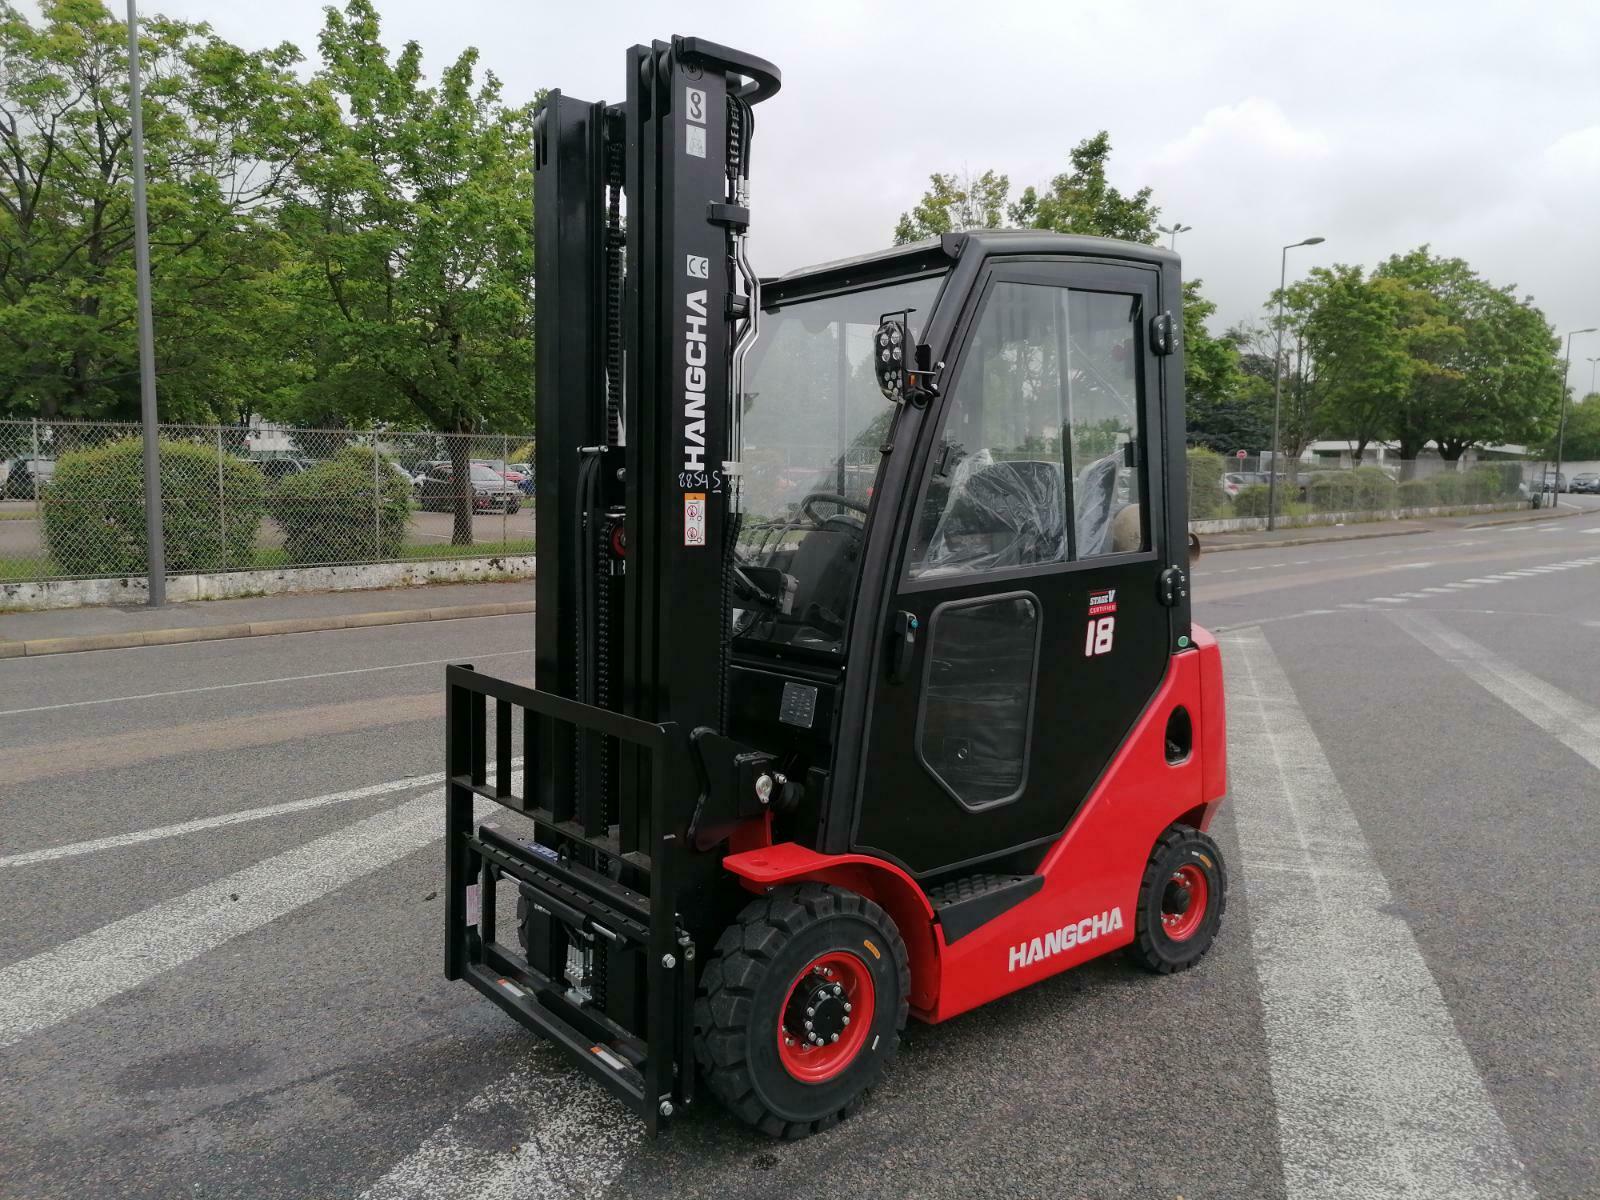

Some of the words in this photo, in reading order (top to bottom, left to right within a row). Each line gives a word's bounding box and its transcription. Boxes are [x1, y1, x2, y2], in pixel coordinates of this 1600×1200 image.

[684, 289, 708, 470] HANGCHA
[1085, 617, 1115, 656] 18
[1008, 906, 1123, 972] HANGCHA
